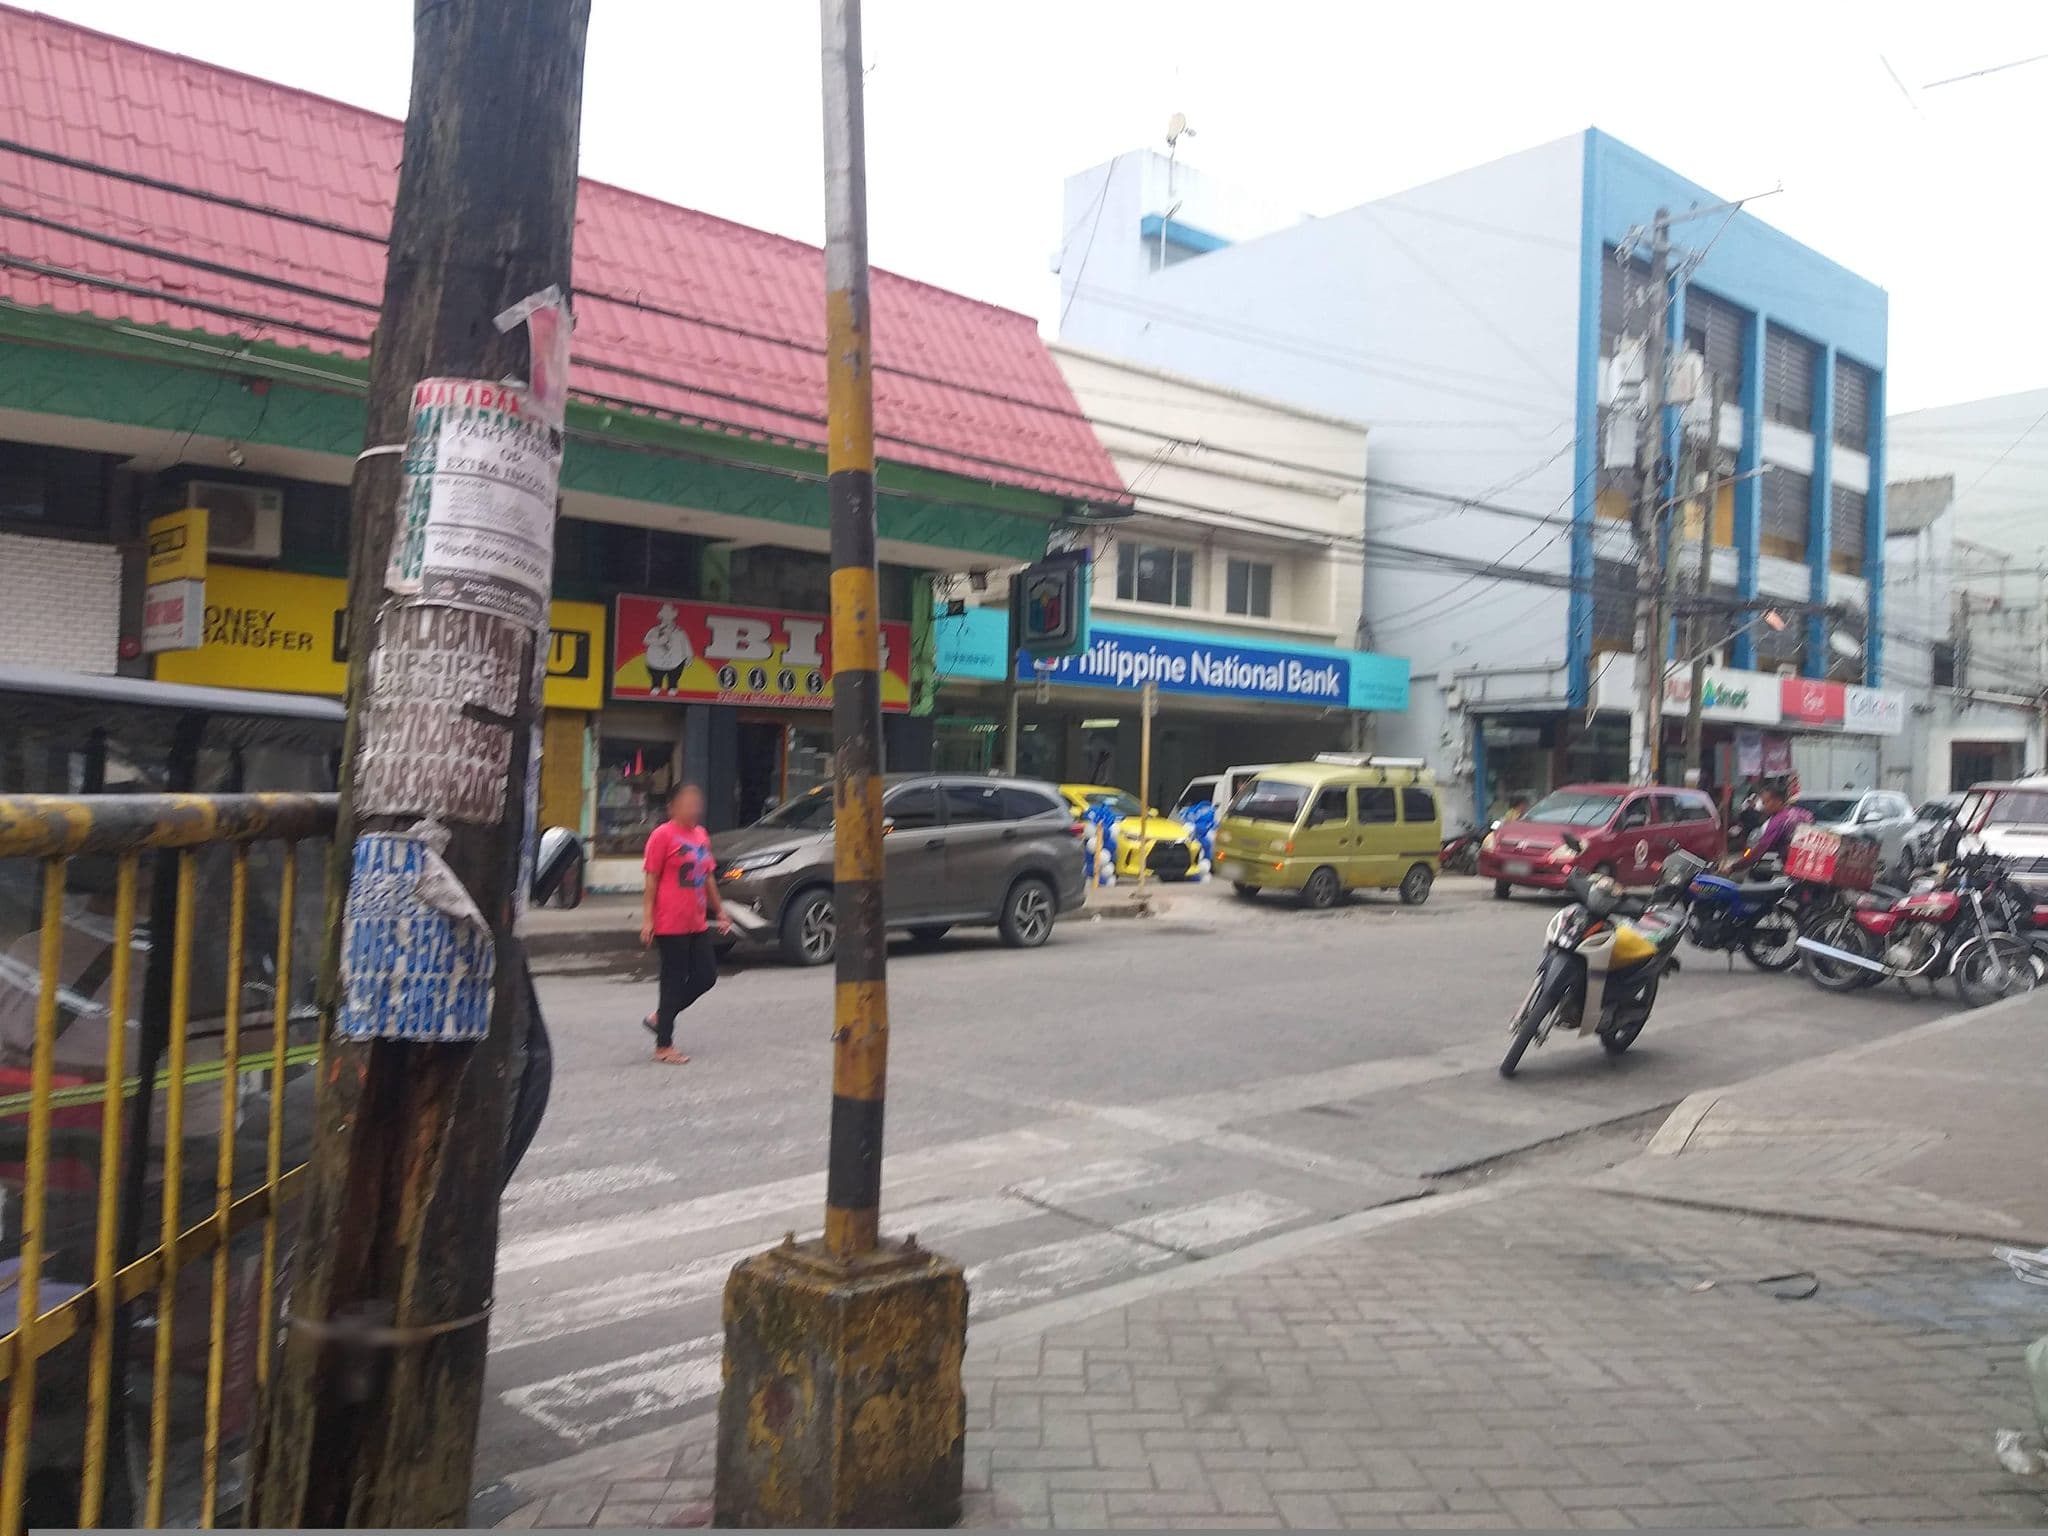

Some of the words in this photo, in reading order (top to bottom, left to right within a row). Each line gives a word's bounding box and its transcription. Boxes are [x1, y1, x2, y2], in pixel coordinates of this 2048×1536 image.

[203, 605, 275, 630] ONEY
[703, 615, 890, 672] BI
[1191, 650, 1285, 692] National
[1287, 660, 1340, 696] Bank
